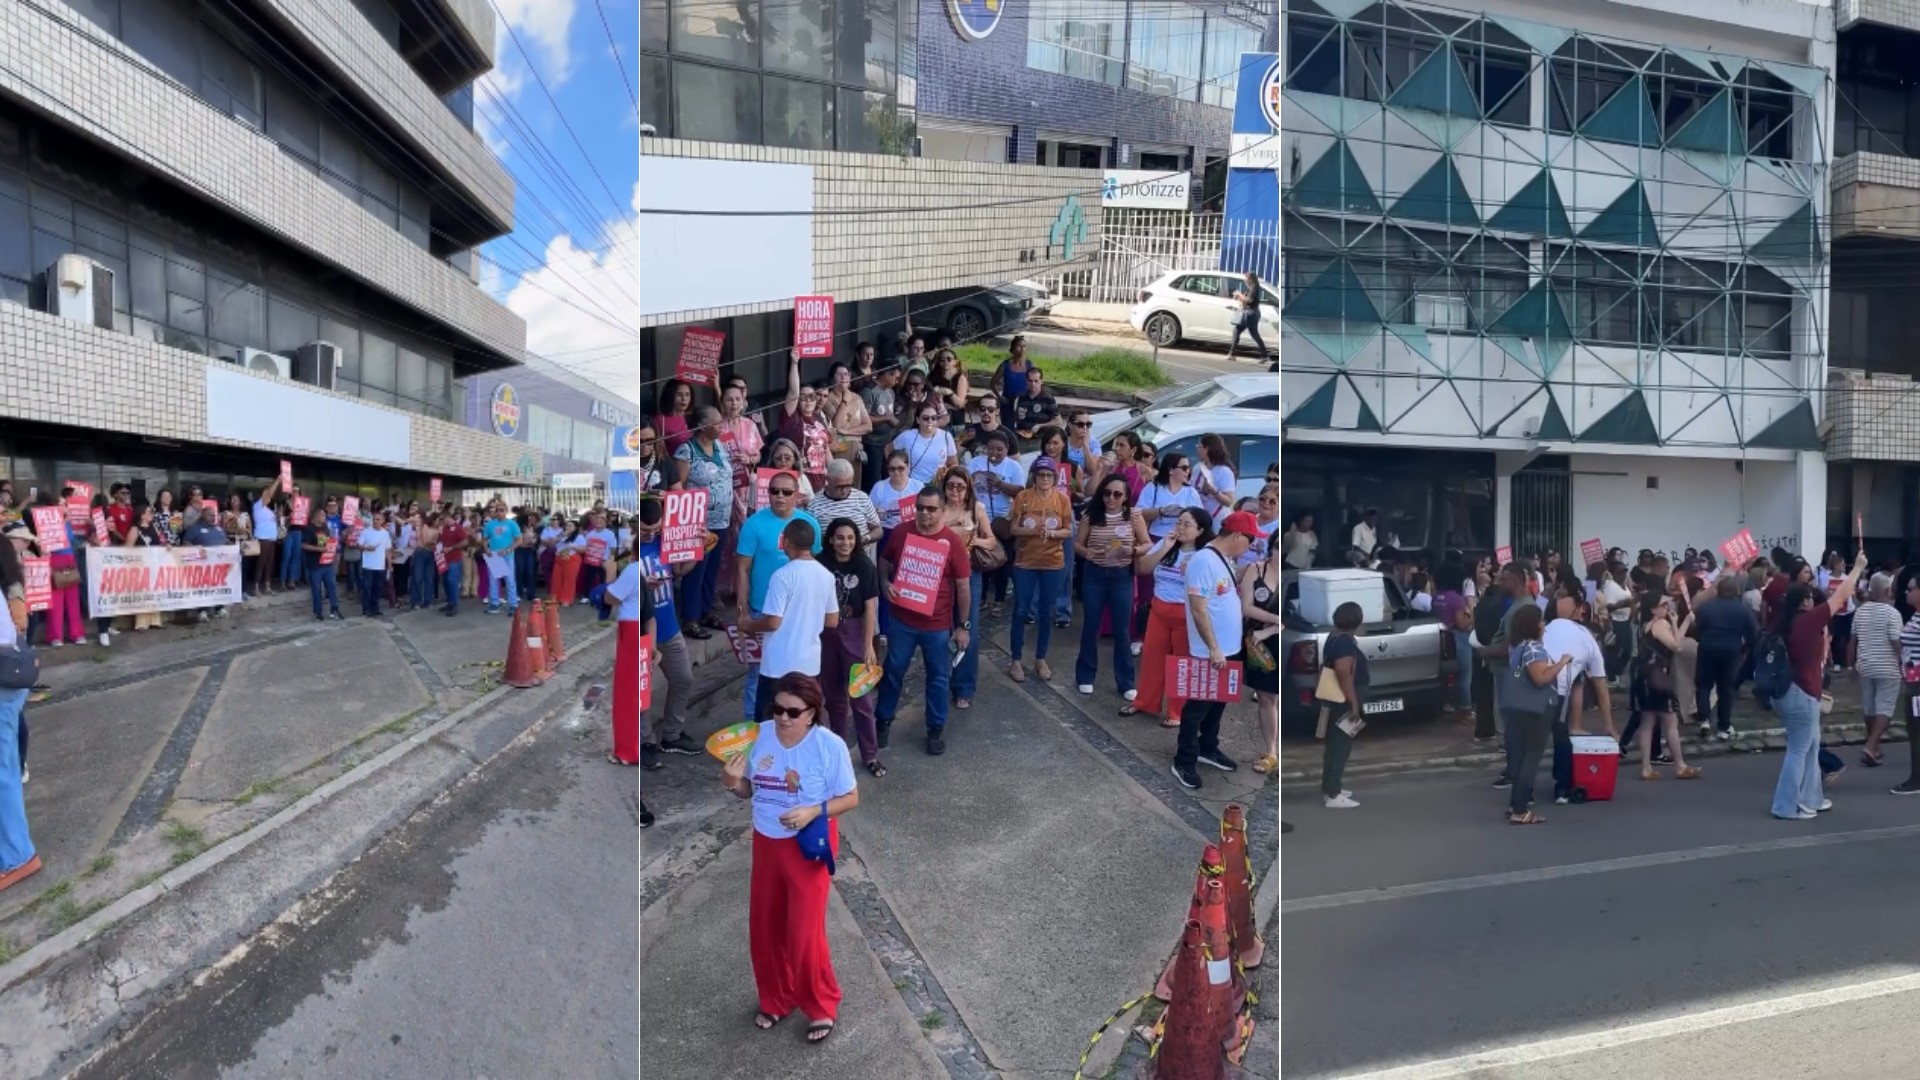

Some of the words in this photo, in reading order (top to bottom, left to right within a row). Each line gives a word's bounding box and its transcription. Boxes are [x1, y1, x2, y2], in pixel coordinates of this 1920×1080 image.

[1120, 180, 1184, 199] priorizze
[798, 300, 831, 319] HORA
[665, 491, 707, 528] POR
[100, 566, 151, 594] HORA
[153, 563, 233, 591] ATIVIDADE
